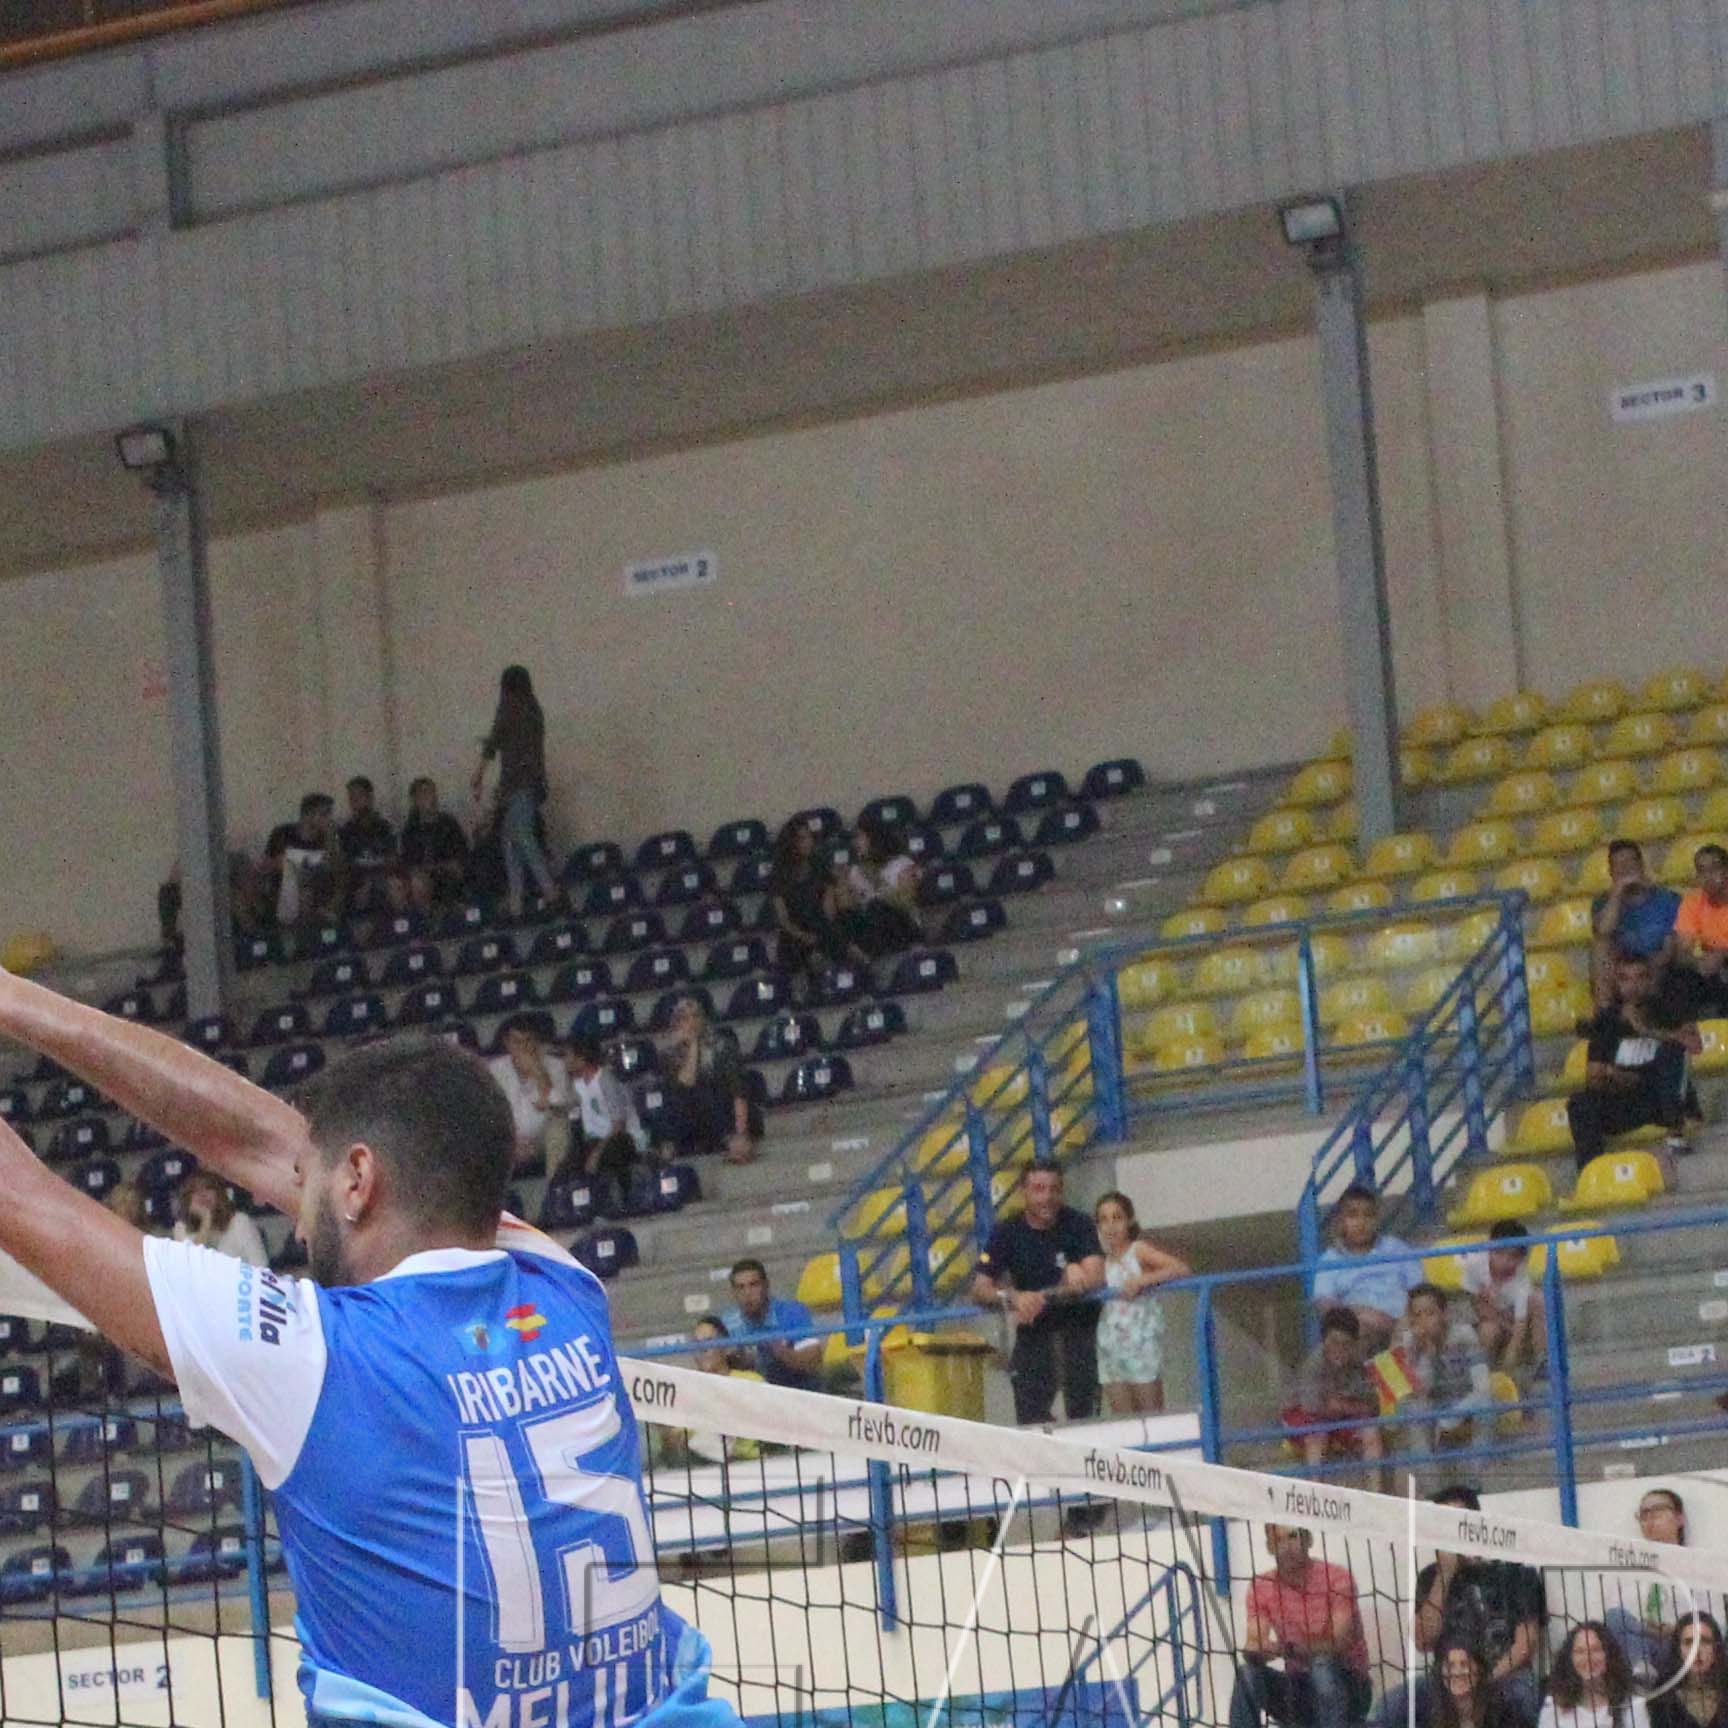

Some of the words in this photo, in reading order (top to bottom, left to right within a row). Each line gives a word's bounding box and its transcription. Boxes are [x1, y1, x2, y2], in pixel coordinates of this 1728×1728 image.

[446, 1334, 612, 1426] IRIBARNE
[847, 1405, 941, 1453] rfevb.com
[1083, 1448, 1162, 1490] rfevb.com
[458, 1393, 662, 1654] 15
[67, 1666, 145, 1691] SECTOR
[155, 1664, 172, 1690] 2
[494, 1651, 561, 1690] CLUB
